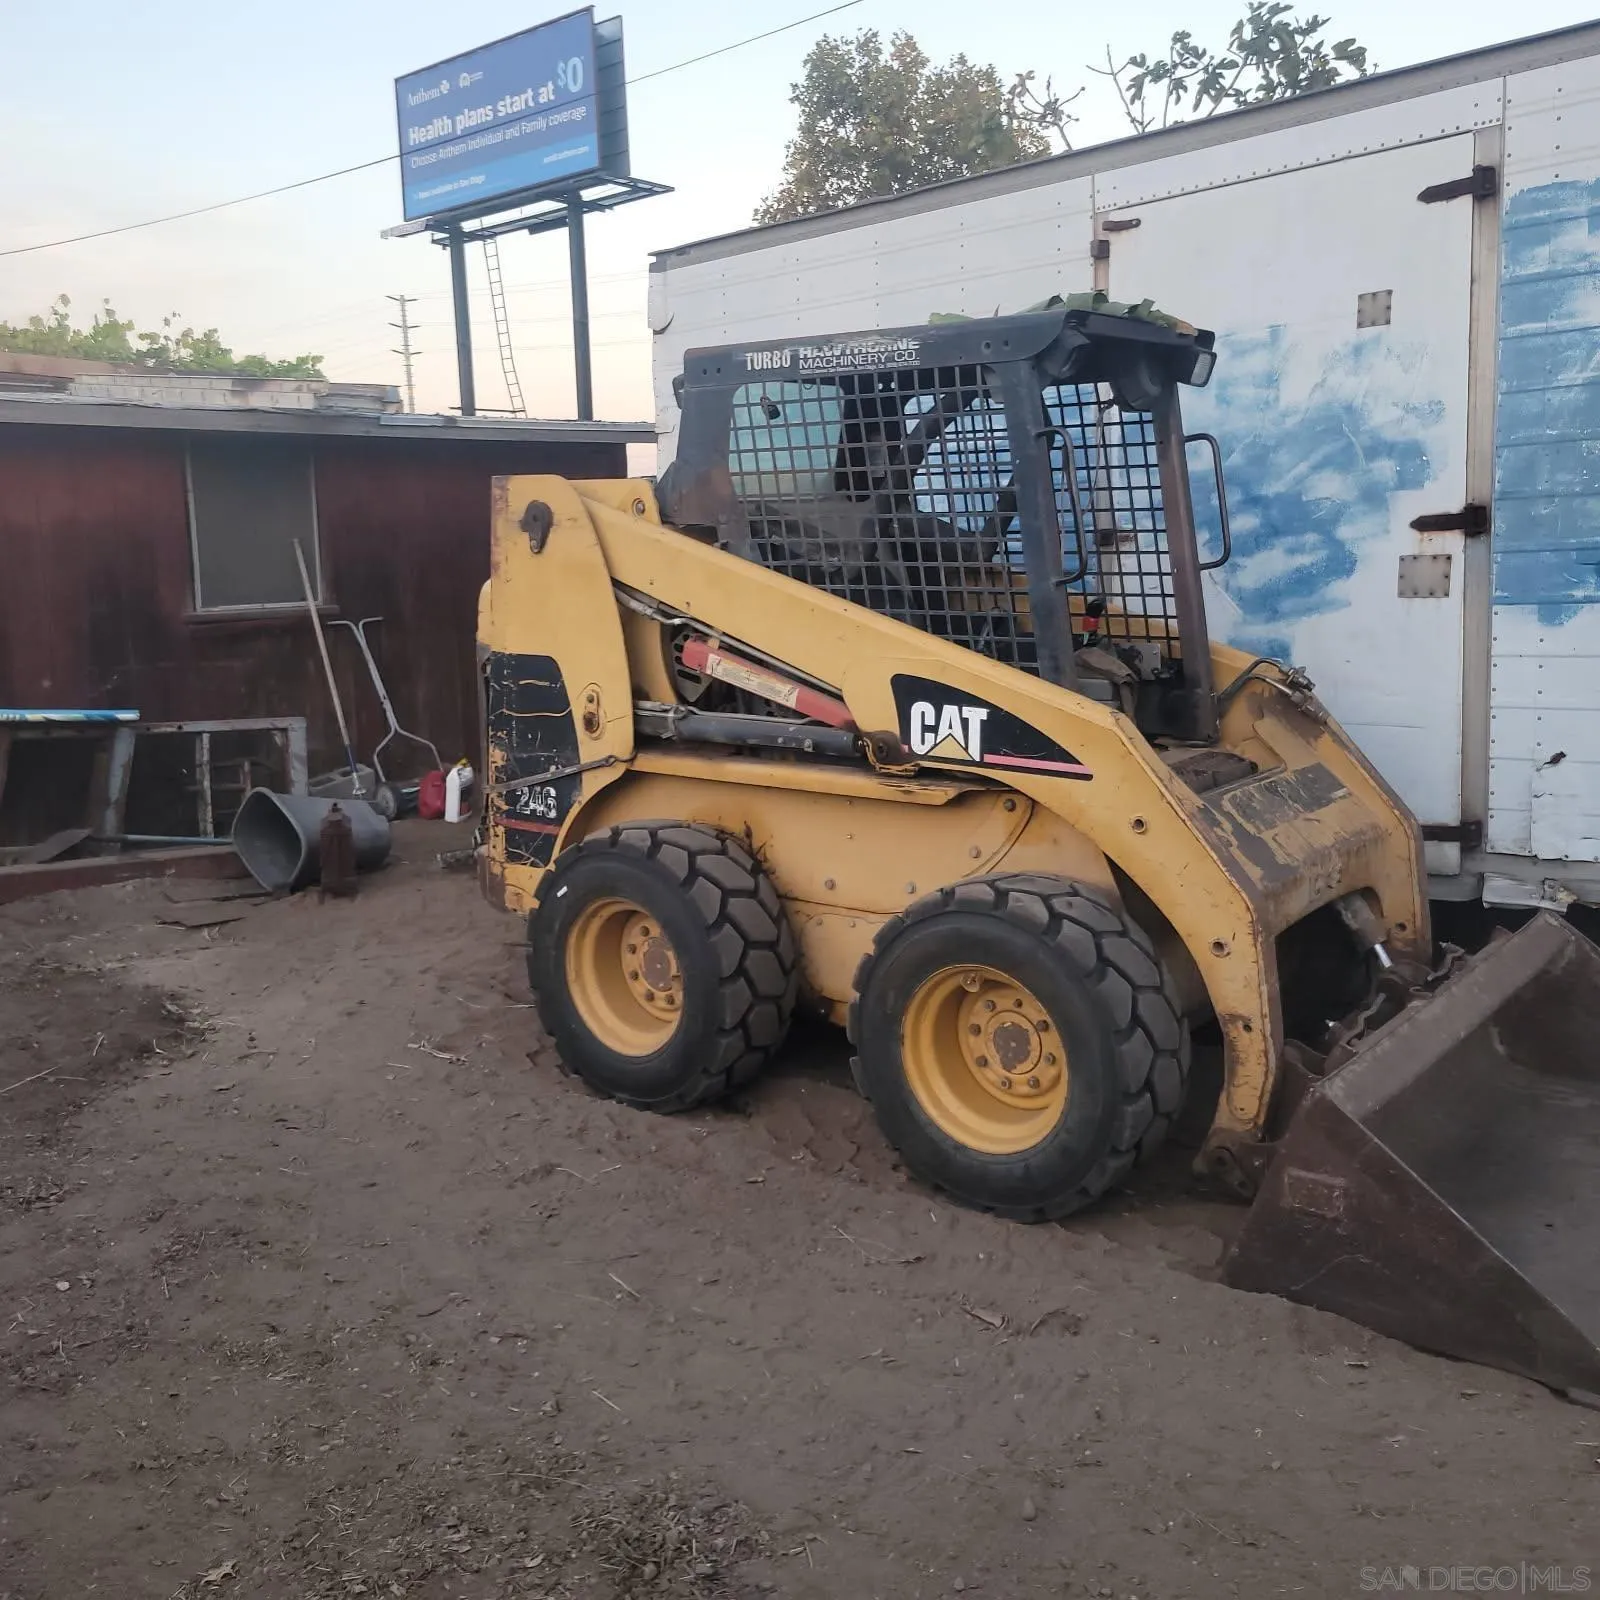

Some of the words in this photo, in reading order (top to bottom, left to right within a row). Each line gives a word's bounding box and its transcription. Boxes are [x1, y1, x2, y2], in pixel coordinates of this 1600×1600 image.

[408, 117, 451, 145] Health
[457, 105, 493, 134] plans
[497, 87, 535, 117] start
[538, 81, 555, 104] at
[468, 128, 505, 151] Individual
[505, 123, 520, 141] and
[522, 116, 548, 136] Family
[549, 105, 587, 127] coverage
[745, 349, 791, 371] TURBO
[800, 352, 888, 369] MACHINERY
[894, 350, 920, 361] CO.
[909, 701, 989, 762] CAT
[516, 786, 557, 818] 246
